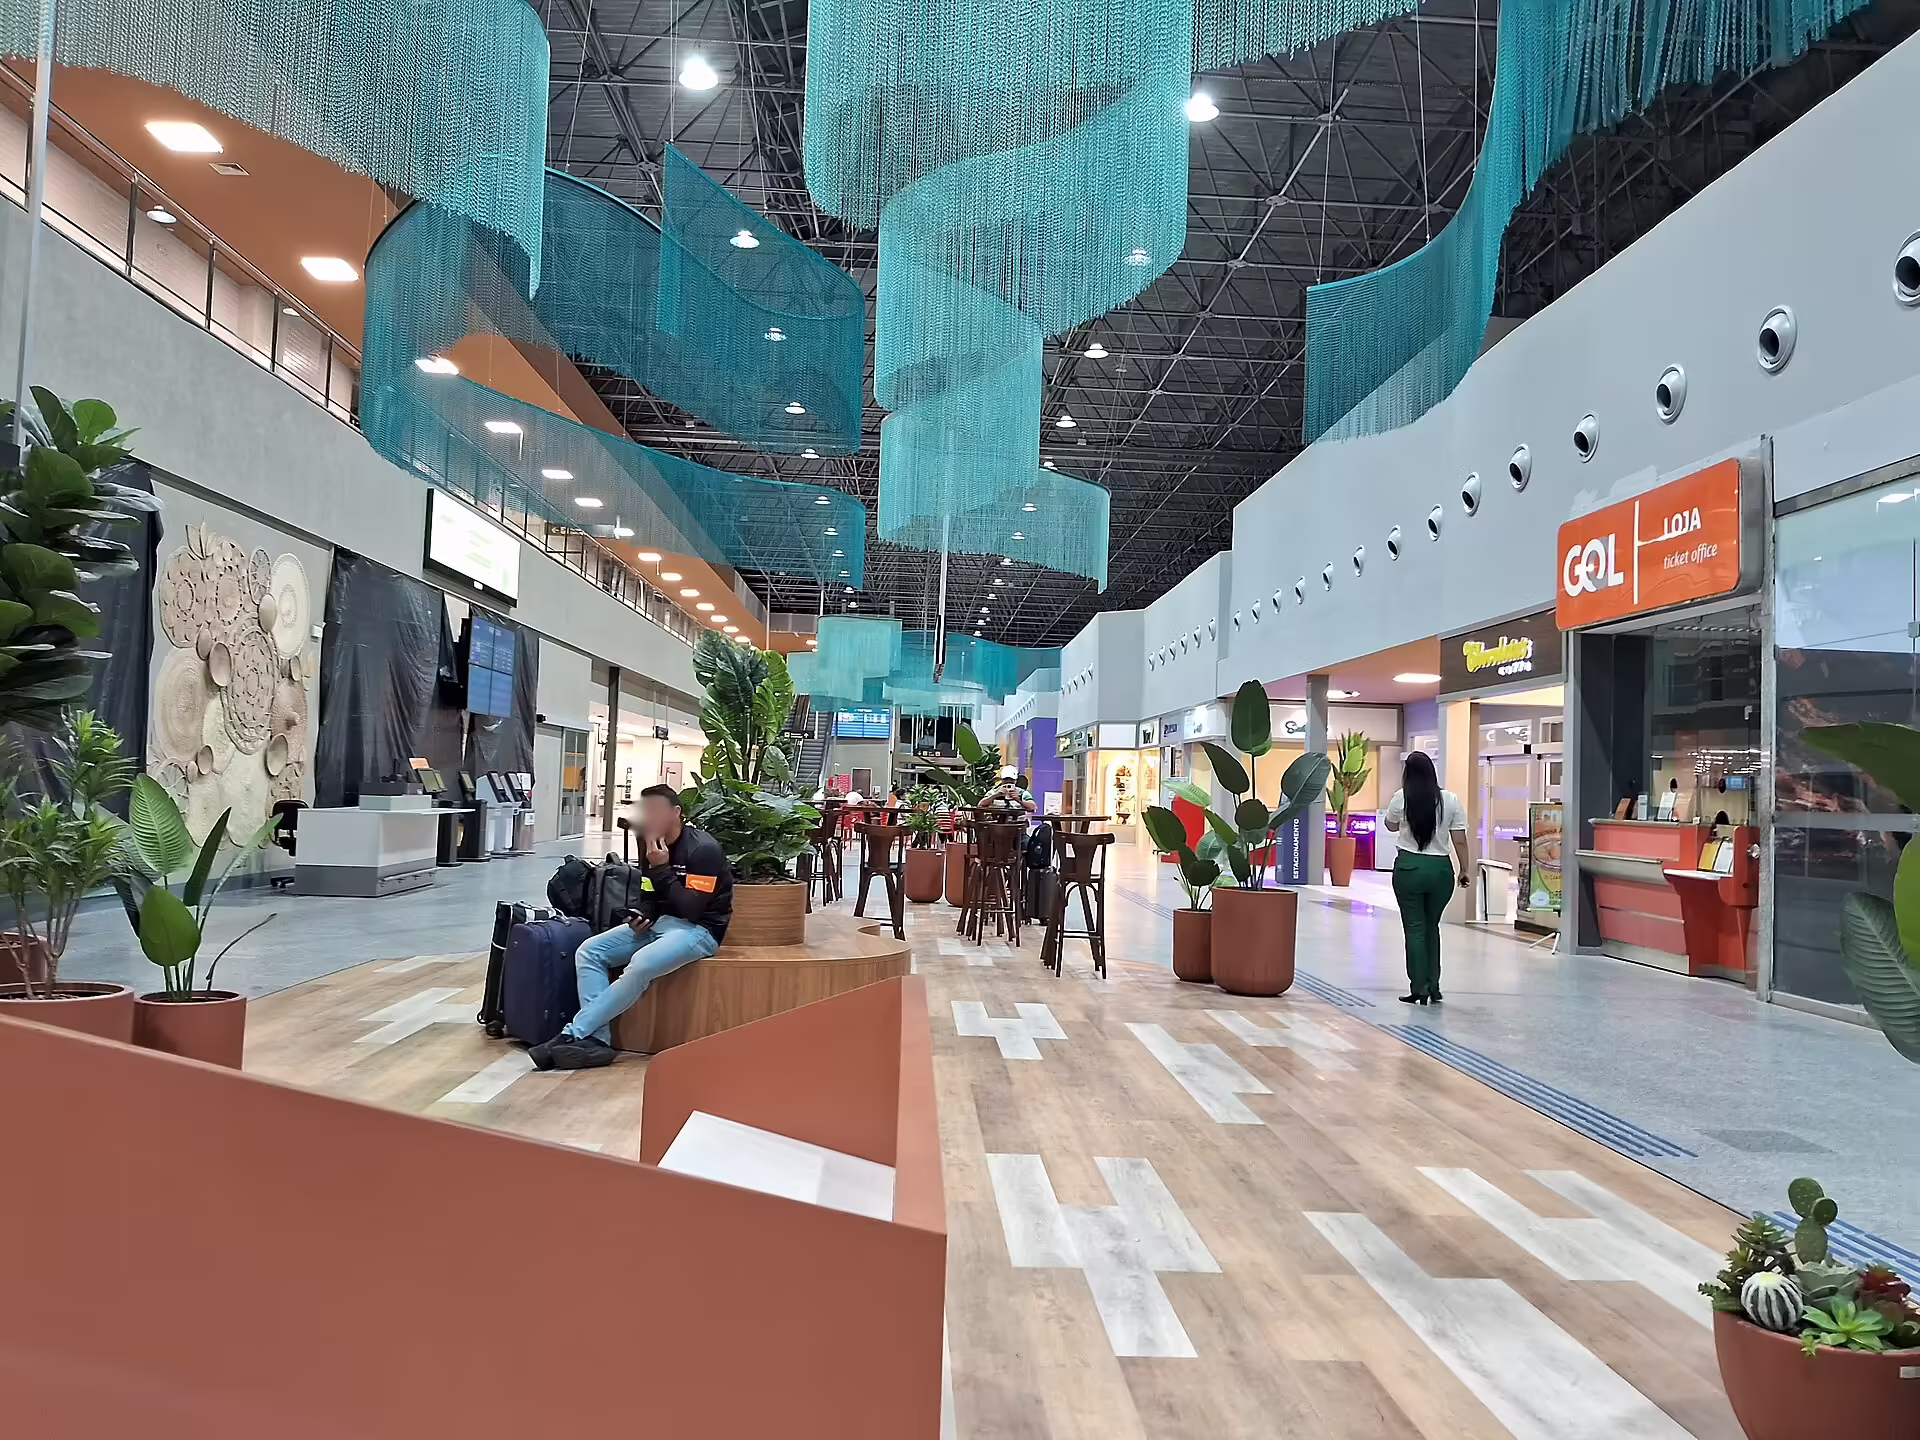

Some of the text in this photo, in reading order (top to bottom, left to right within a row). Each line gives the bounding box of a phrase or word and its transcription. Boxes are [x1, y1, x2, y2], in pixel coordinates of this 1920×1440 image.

[1663, 507, 1702, 536] LOJA
[1563, 533, 1624, 597] GOL
[1663, 542, 1718, 570] ticket office
